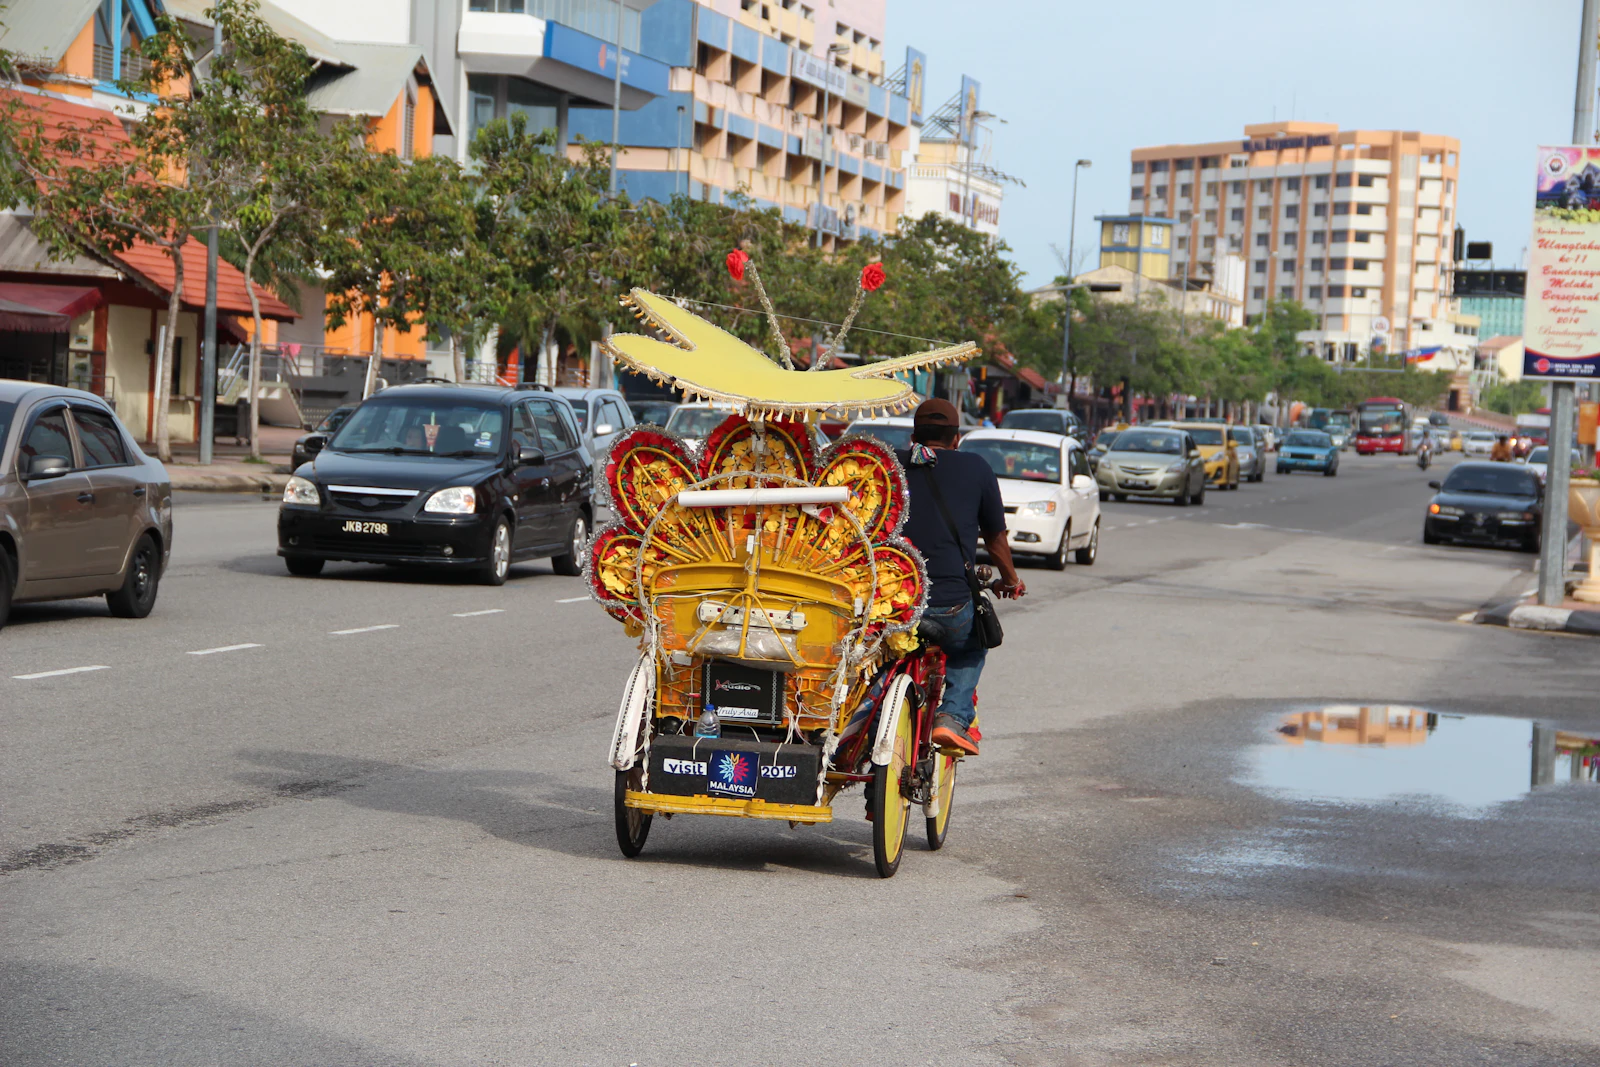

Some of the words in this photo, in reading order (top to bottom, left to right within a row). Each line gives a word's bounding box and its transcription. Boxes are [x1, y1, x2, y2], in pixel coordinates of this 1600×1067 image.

[1537, 238, 1600, 253] Ulangtahu
[1550, 278, 1593, 288] Melaka
[1542, 290, 1600, 303] Bersejarah
[1557, 316, 1580, 324] 2014
[718, 706, 738, 718] Truly
[738, 708, 758, 717] Asia
[668, 760, 704, 775] visit
[761, 766, 796, 777] 2014
[709, 780, 754, 795] MALAYSIA
